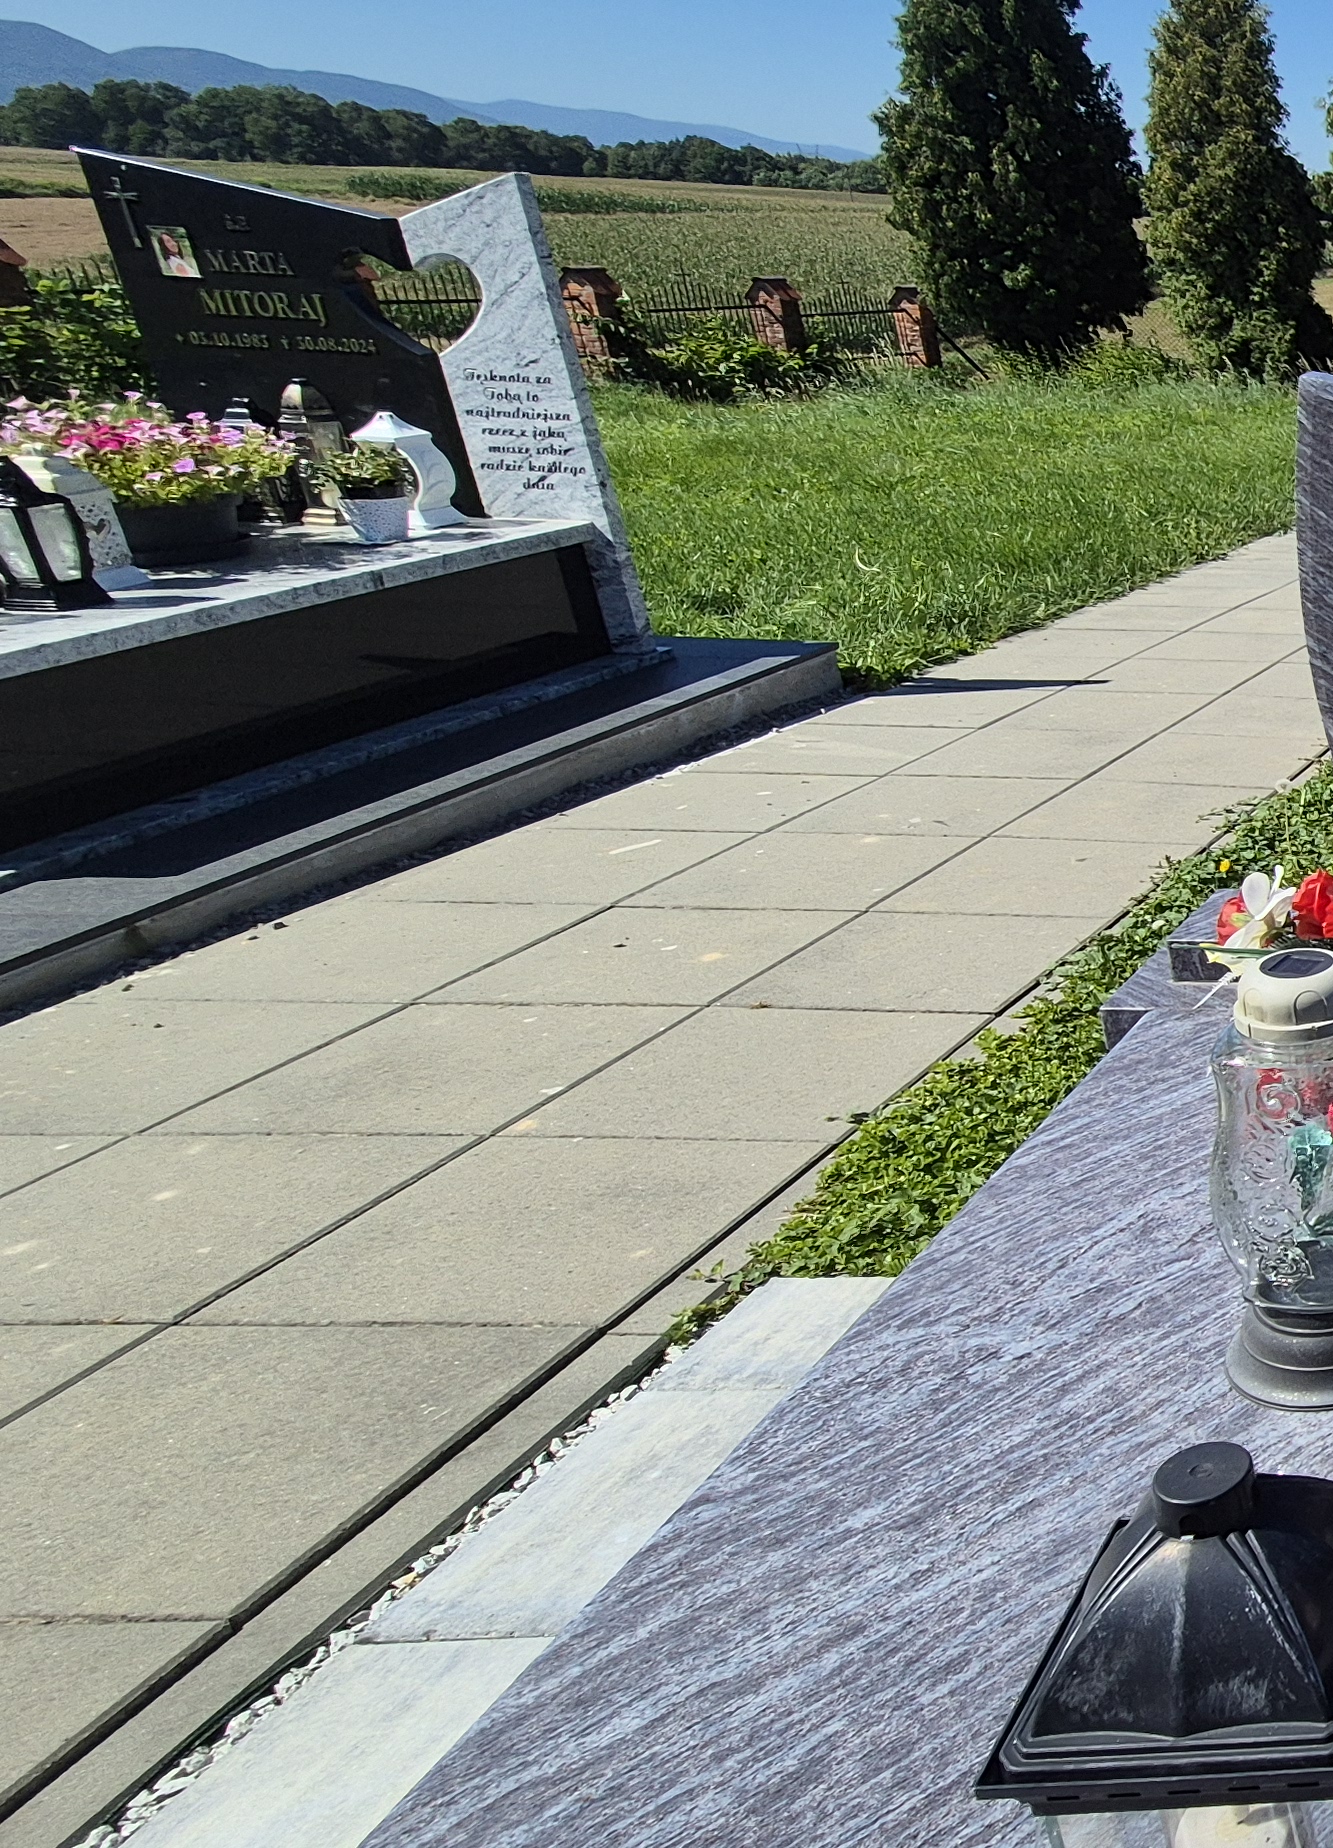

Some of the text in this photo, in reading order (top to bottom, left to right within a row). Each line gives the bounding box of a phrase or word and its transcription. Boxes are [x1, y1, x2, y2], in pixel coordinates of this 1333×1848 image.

[204, 249, 295, 276] MARTA
[200, 288, 327, 327] MITORAJ
[535, 375, 552, 385] za
[527, 390, 539, 402] to
[465, 406, 571, 423] najtrudniejsza
[532, 425, 567, 442] jaką
[528, 460, 586, 477] każdego
[522, 478, 555, 491] dnia
